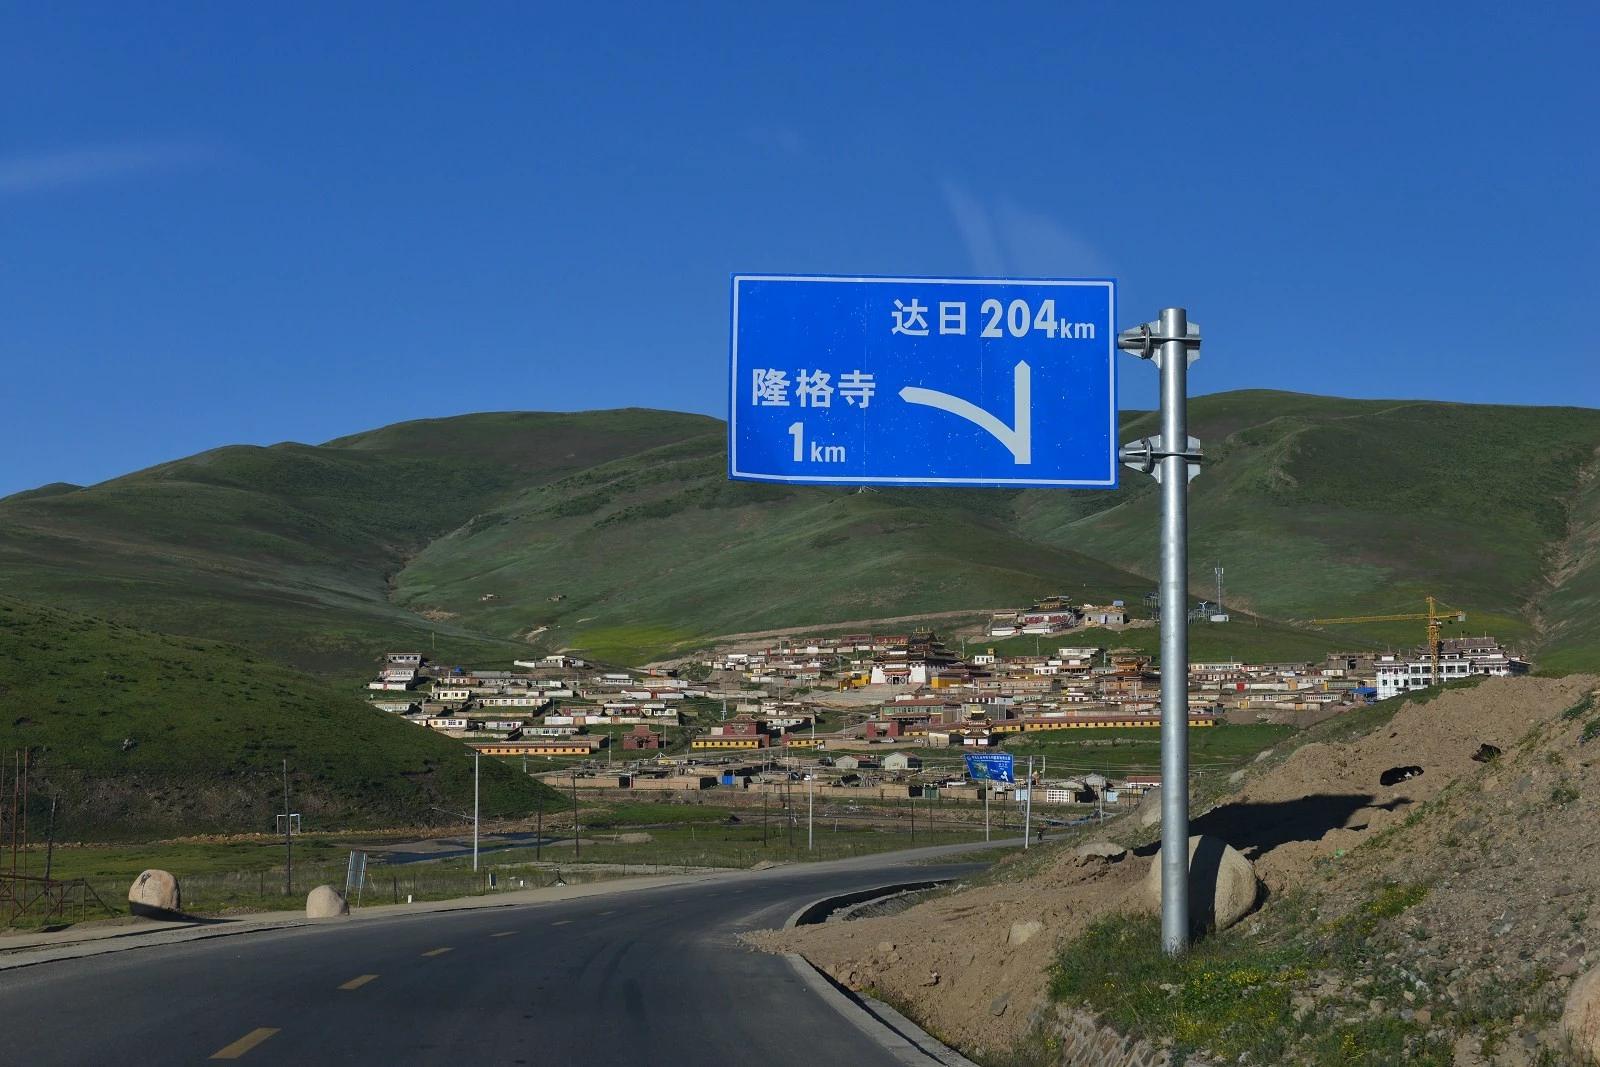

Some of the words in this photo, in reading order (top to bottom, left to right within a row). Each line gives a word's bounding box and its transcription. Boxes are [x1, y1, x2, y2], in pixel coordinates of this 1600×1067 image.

[891, 298, 966, 336] 达日
[980, 298, 1095, 339] 204km
[752, 368, 876, 408] 隆格寺
[788, 422, 846, 462] 1km
